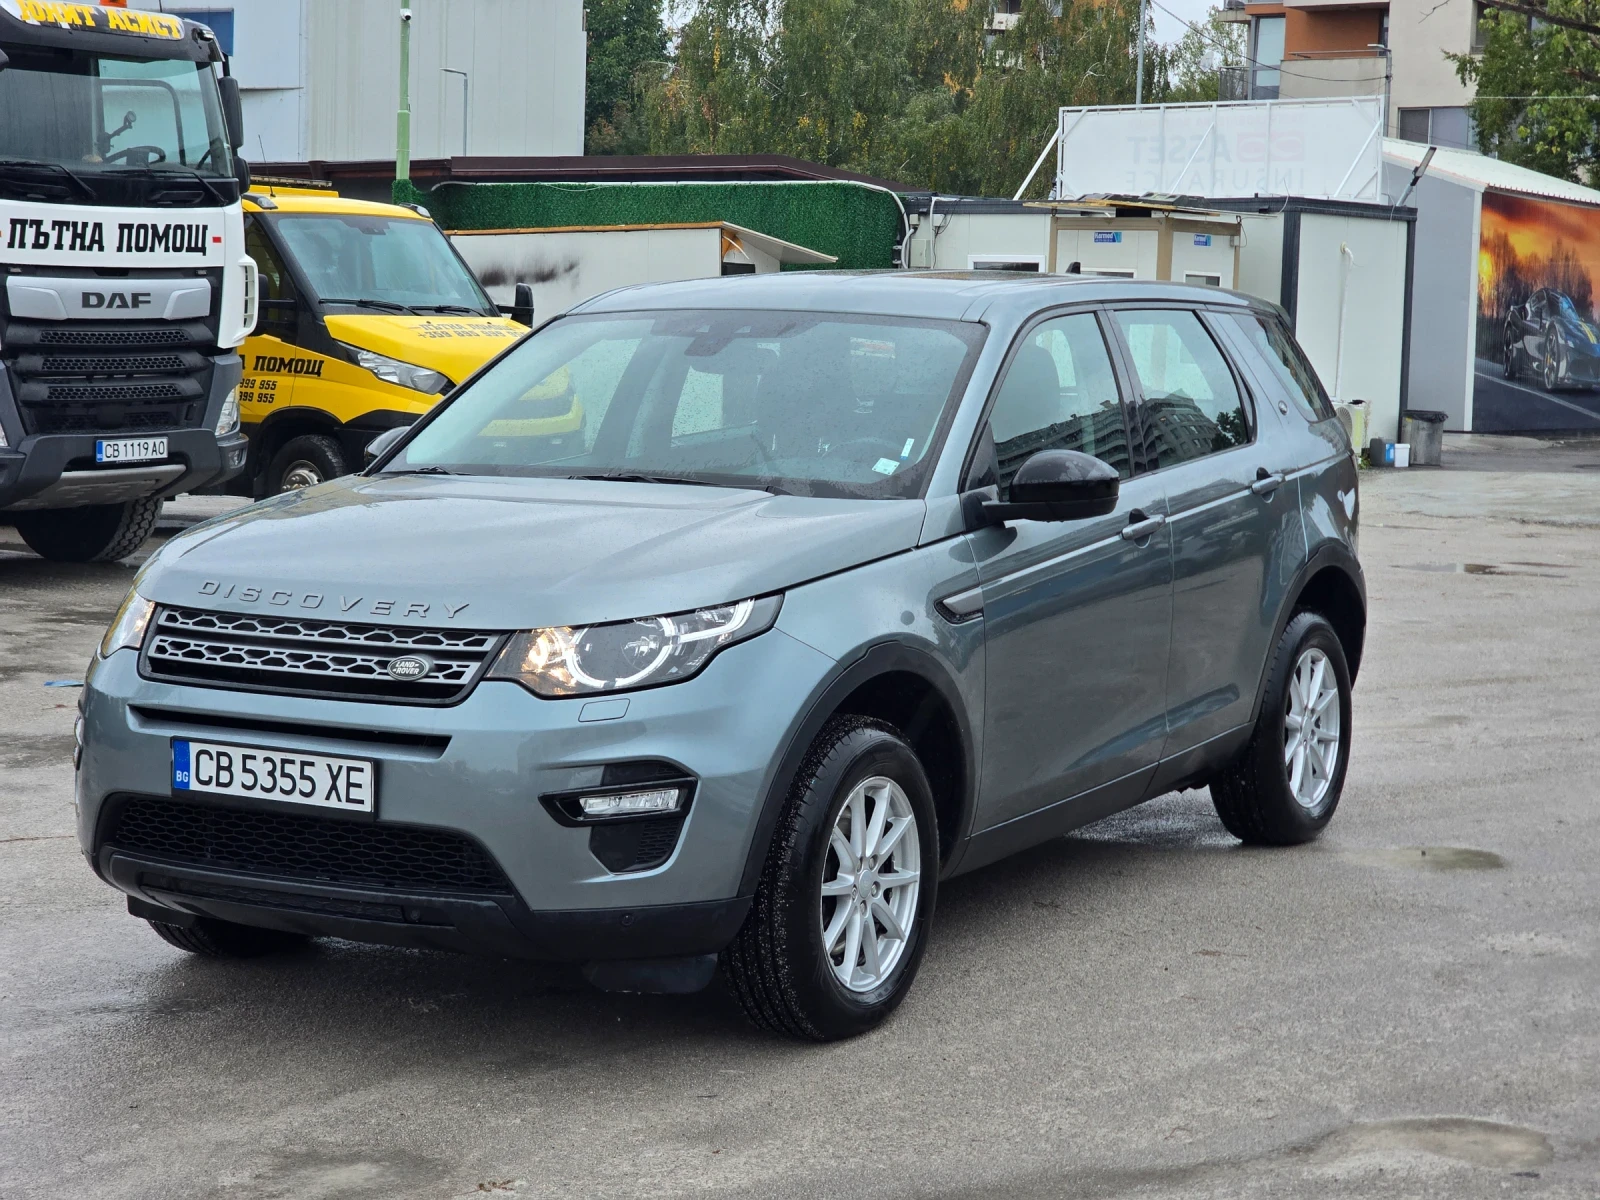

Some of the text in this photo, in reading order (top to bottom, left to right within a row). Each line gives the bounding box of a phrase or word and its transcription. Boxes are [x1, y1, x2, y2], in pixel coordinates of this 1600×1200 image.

[106, 8, 182, 40] АСИСТ
[7, 218, 208, 256] ПЪТНА ПОМОЩ
[81, 291, 152, 309] DAF
[253, 355, 325, 377] ПОМОЩ
[259, 380, 278, 390] 955
[257, 393, 275, 403] 955
[123, 442, 149, 458] 1119
[198, 579, 470, 619] DISCOVERY
[395, 667, 420, 675] ROVER
[176, 770, 189, 783] BG
[195, 749, 365, 805] CB 5355 XE
